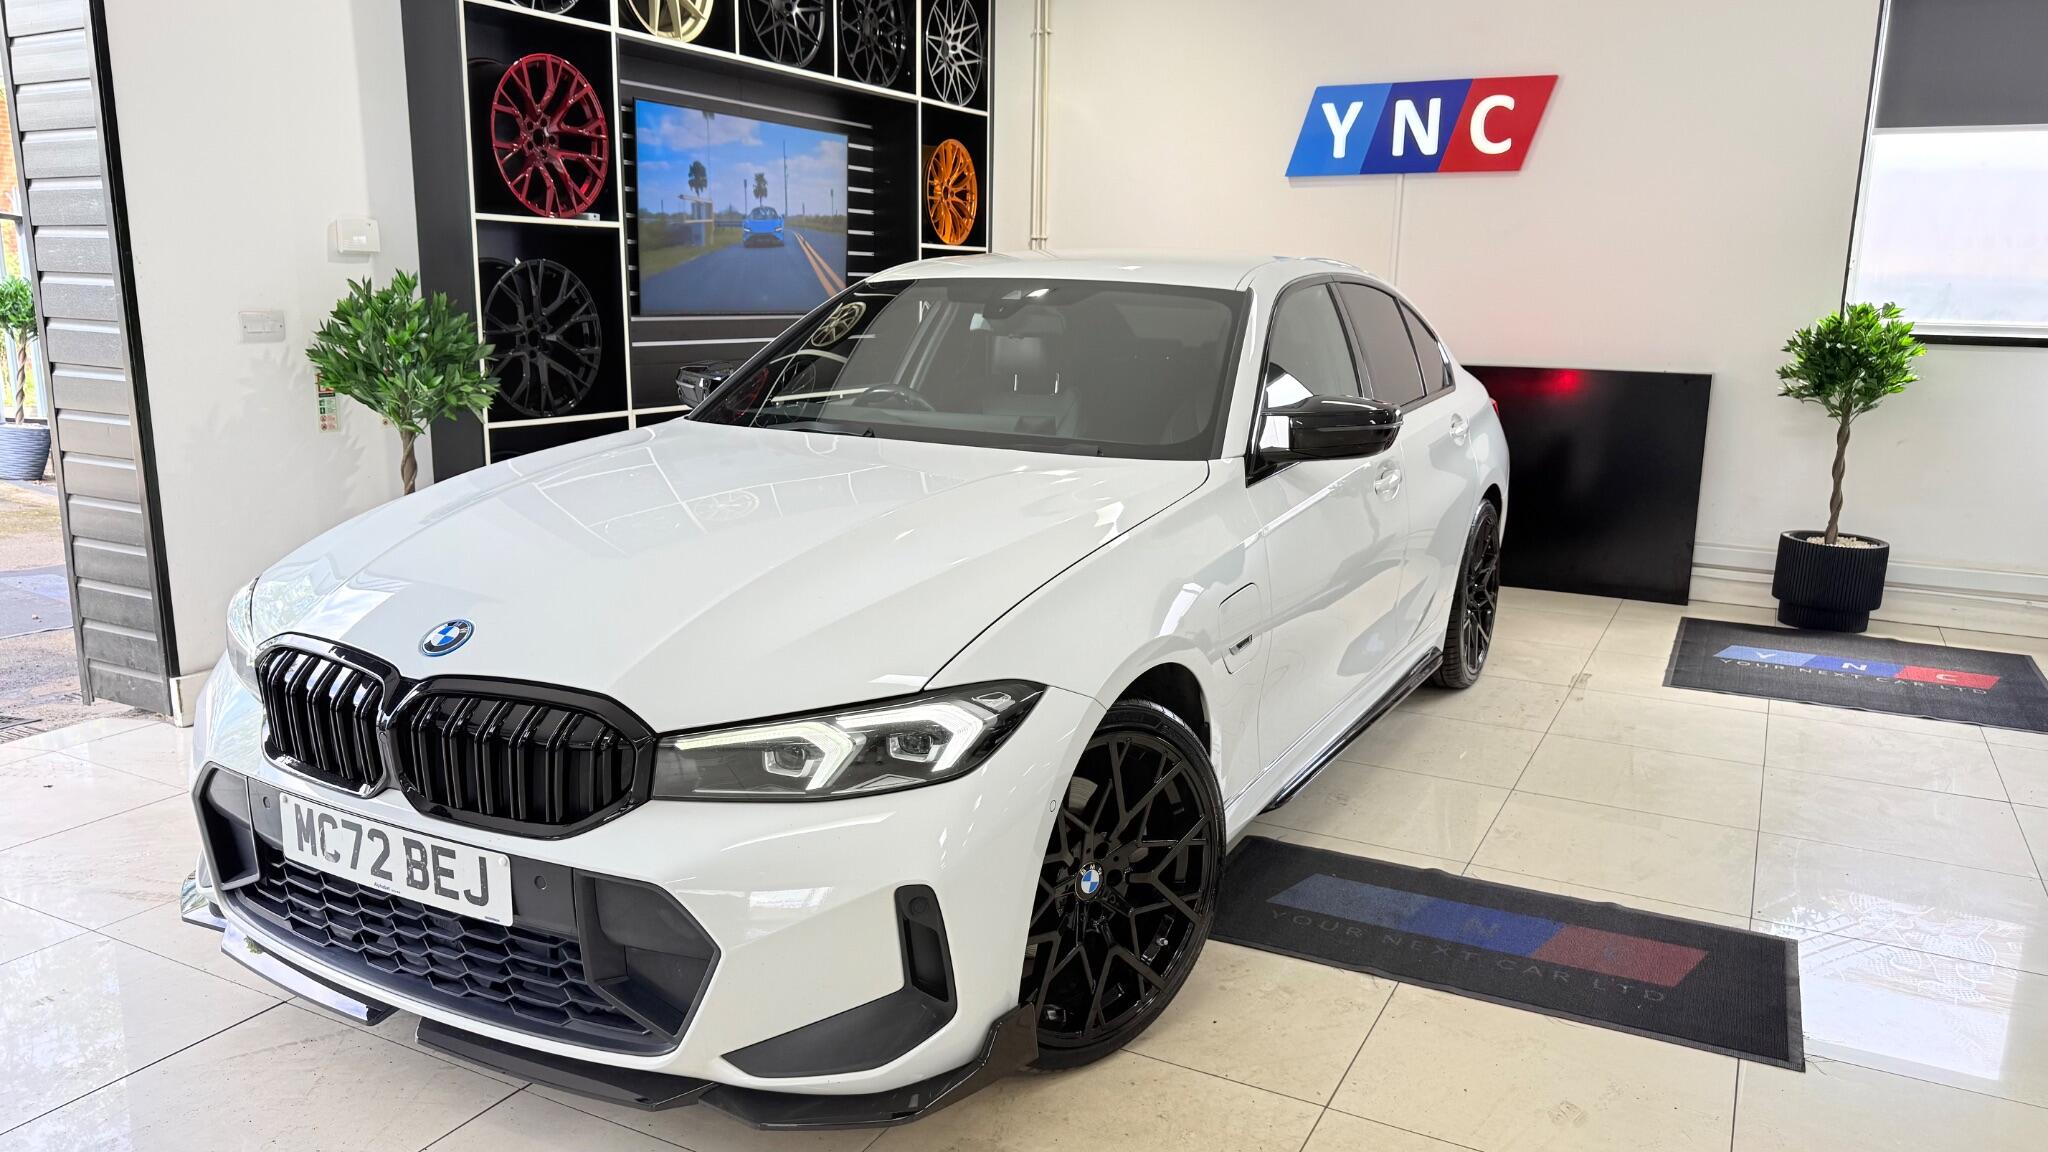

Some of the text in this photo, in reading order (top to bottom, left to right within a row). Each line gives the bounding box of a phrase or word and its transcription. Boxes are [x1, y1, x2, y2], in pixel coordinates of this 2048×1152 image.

[1321, 94, 1515, 158] YNC
[1800, 668, 1862, 679] NEXT
[294, 803, 490, 907] MC72 BEJ
[1271, 909, 1665, 1001] YOUR NEXT CAR LTD
